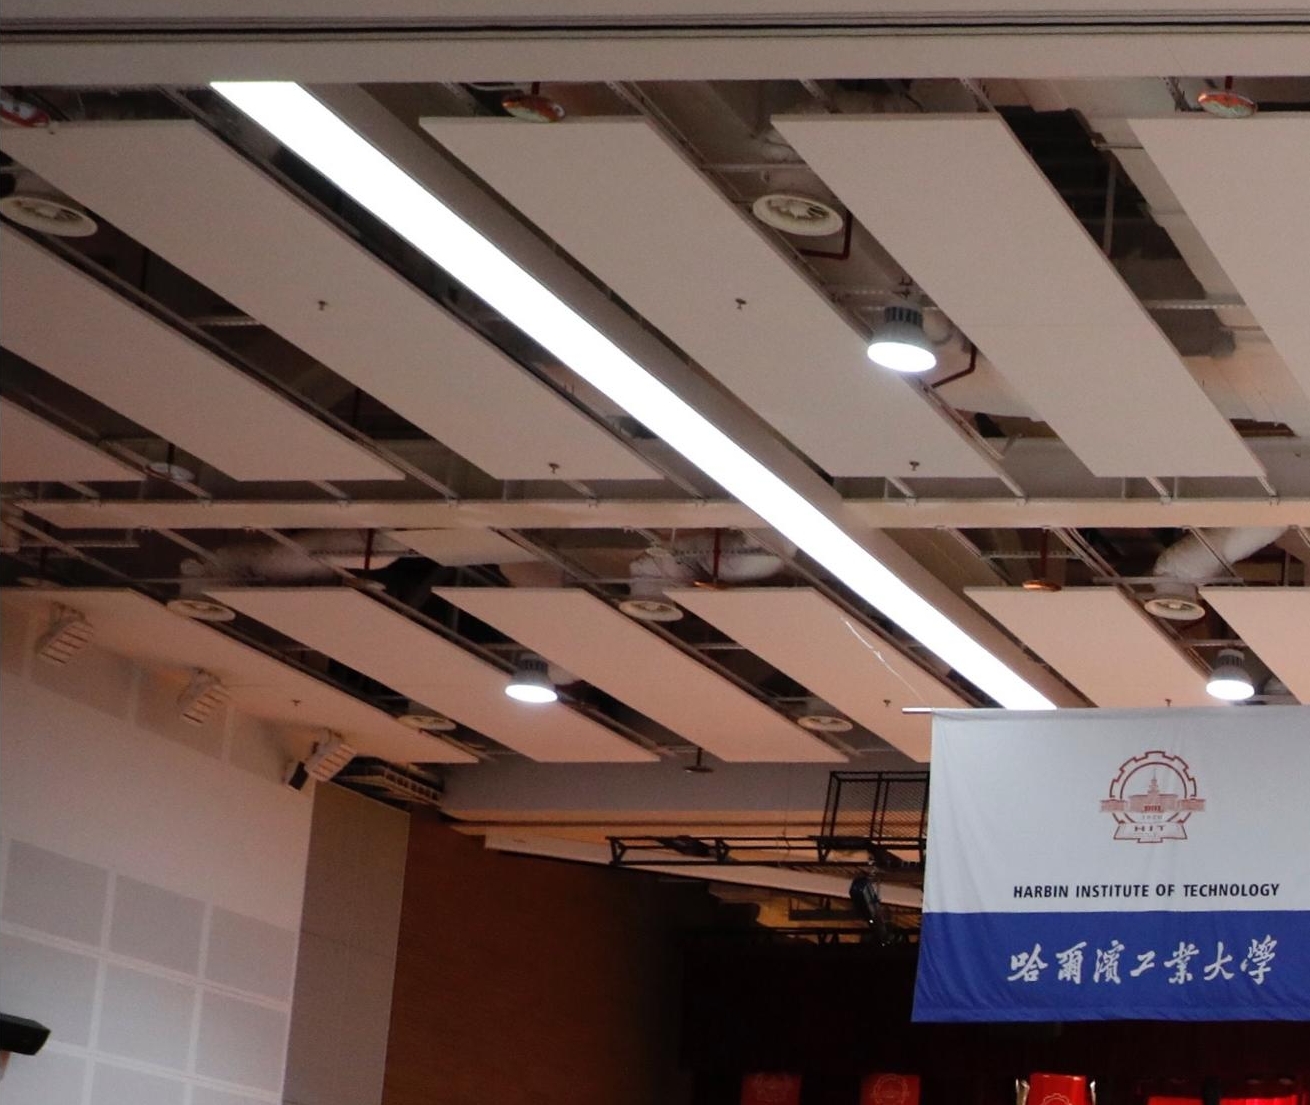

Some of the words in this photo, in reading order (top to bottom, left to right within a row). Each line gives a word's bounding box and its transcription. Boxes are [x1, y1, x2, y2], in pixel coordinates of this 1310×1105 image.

[1013, 885, 1069, 898] HARBIN
[1076, 884, 1150, 898] INSTITUTE
[1155, 883, 1175, 897] OF
[1183, 882, 1280, 897] TECHNOLOGY
